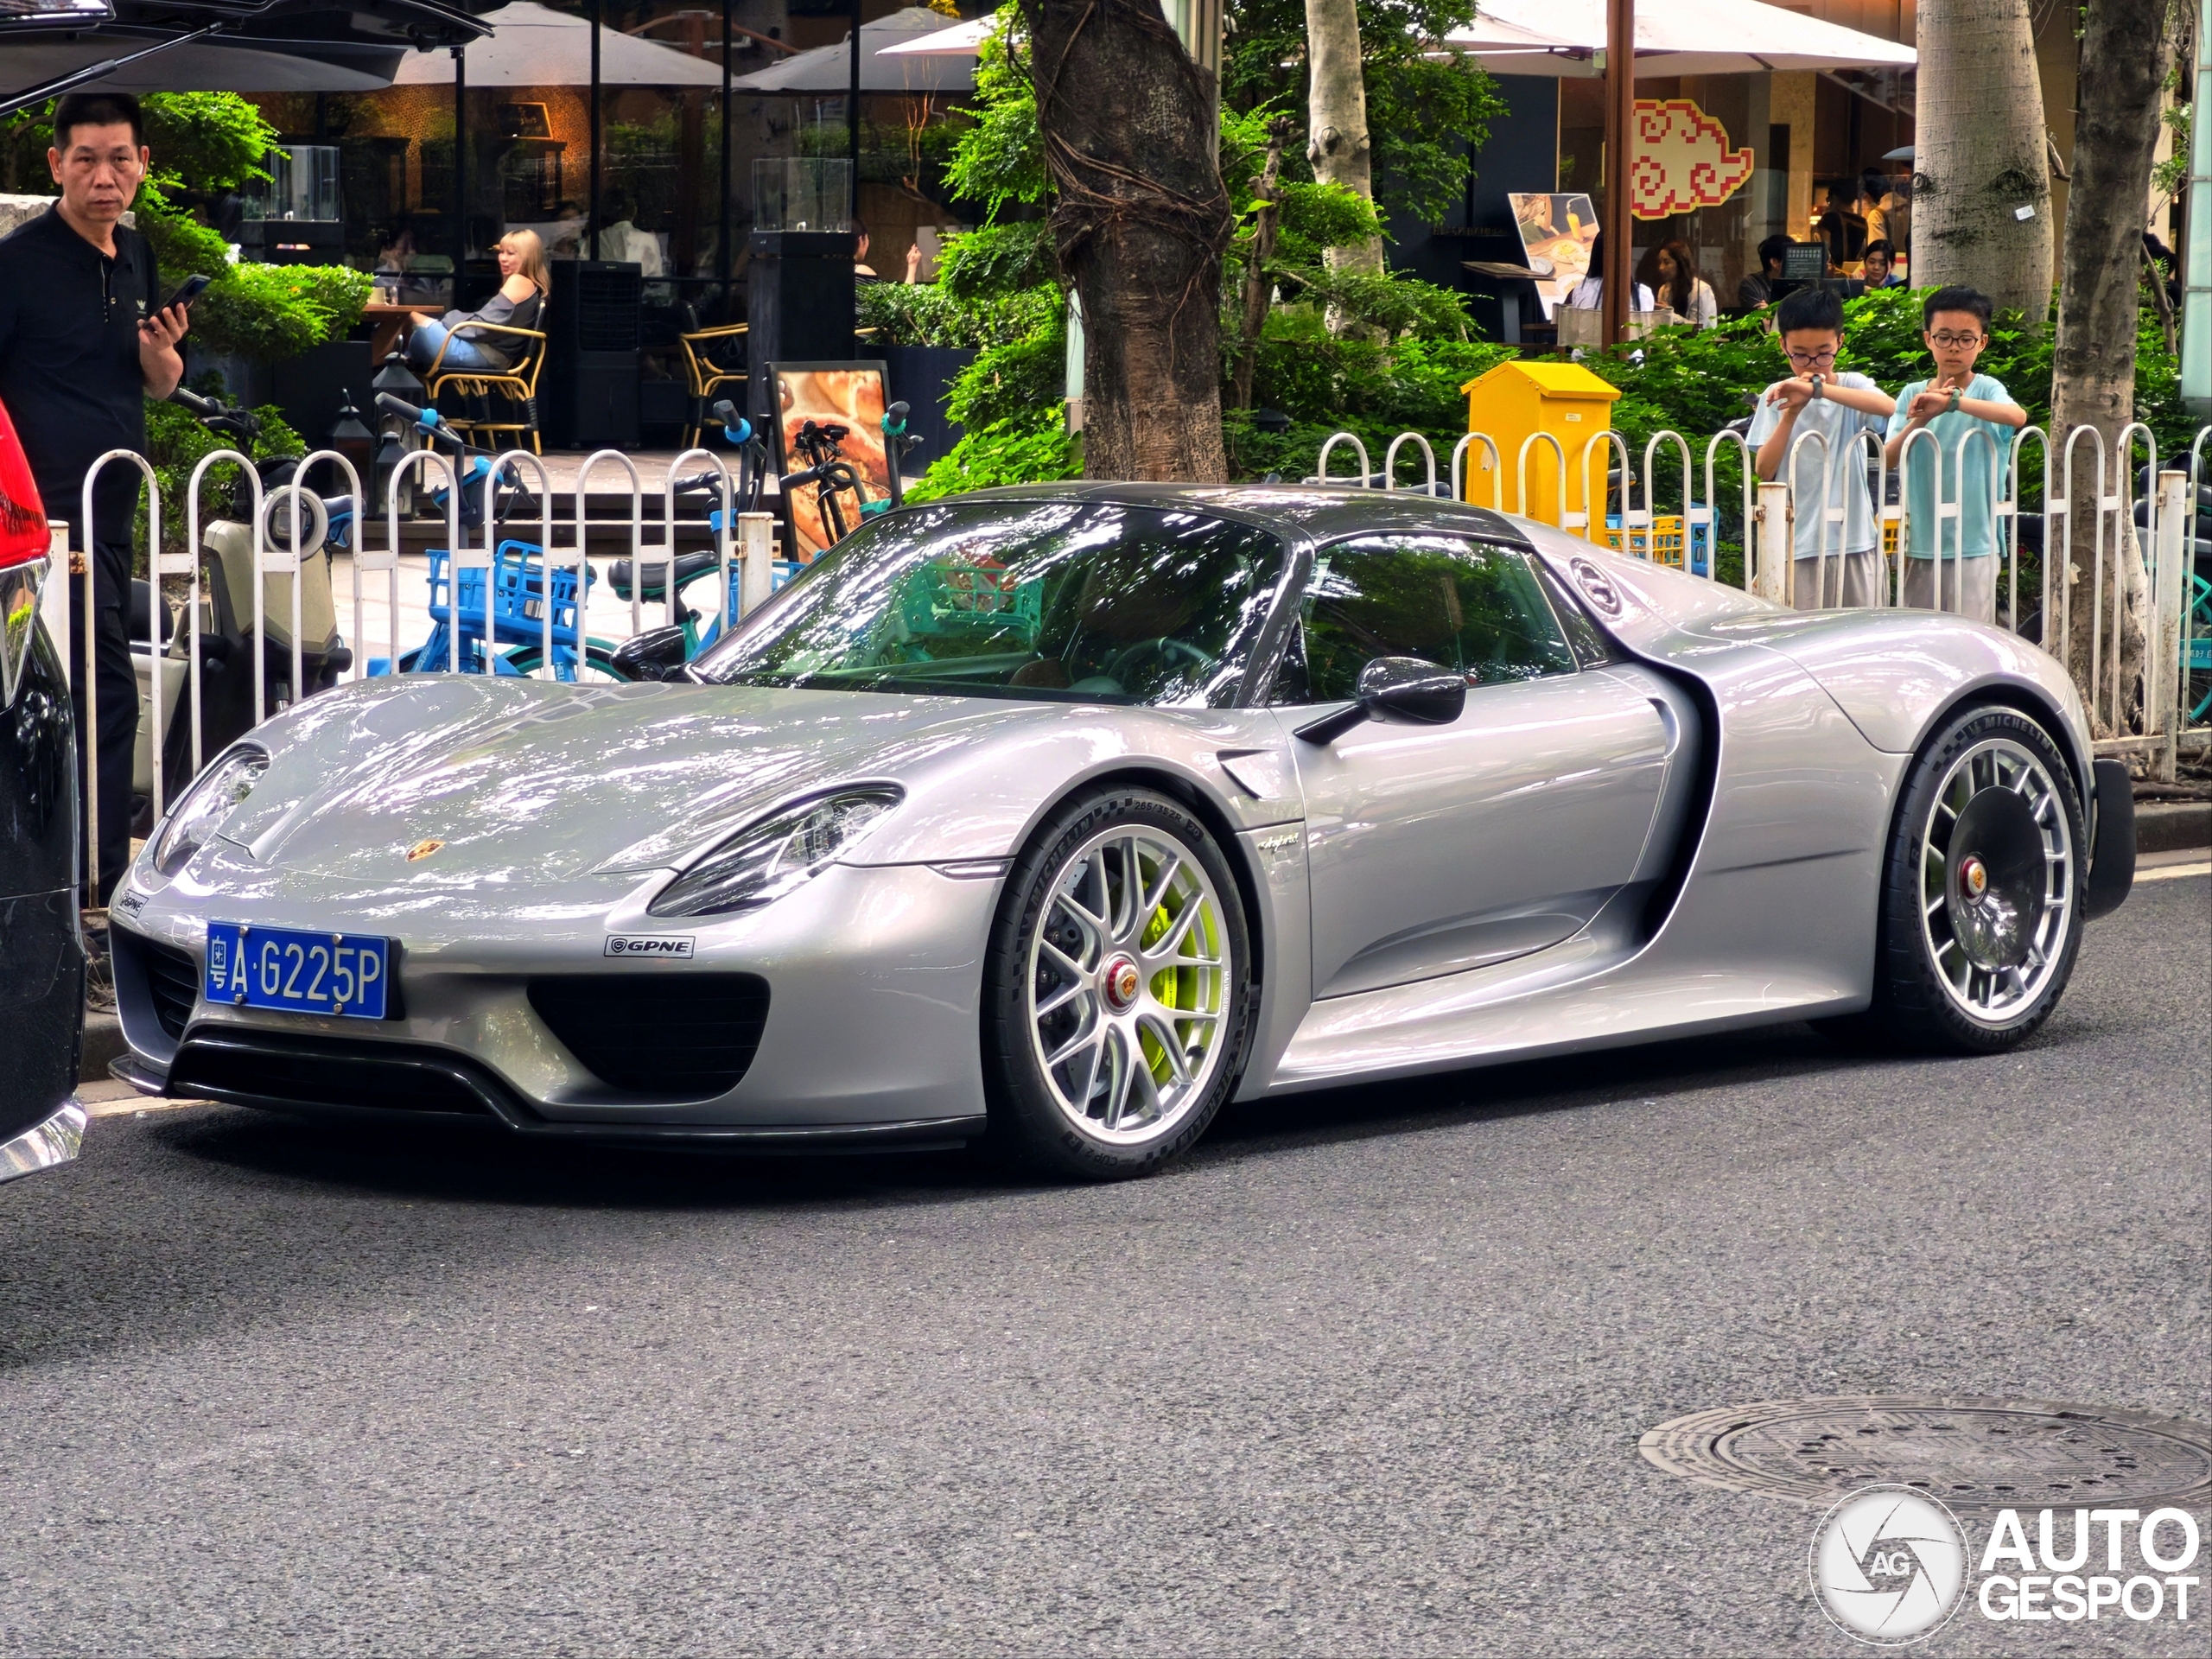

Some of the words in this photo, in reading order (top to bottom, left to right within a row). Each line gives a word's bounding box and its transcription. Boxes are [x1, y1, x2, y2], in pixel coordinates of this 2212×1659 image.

[1984, 715, 2051, 751] MICHELIN
[1028, 816, 1092, 910] MICHELIN
[627, 940, 690, 953] GPNE
[1068, 1135, 1080, 1148] R
[1094, 1153, 1118, 1166] CUP
